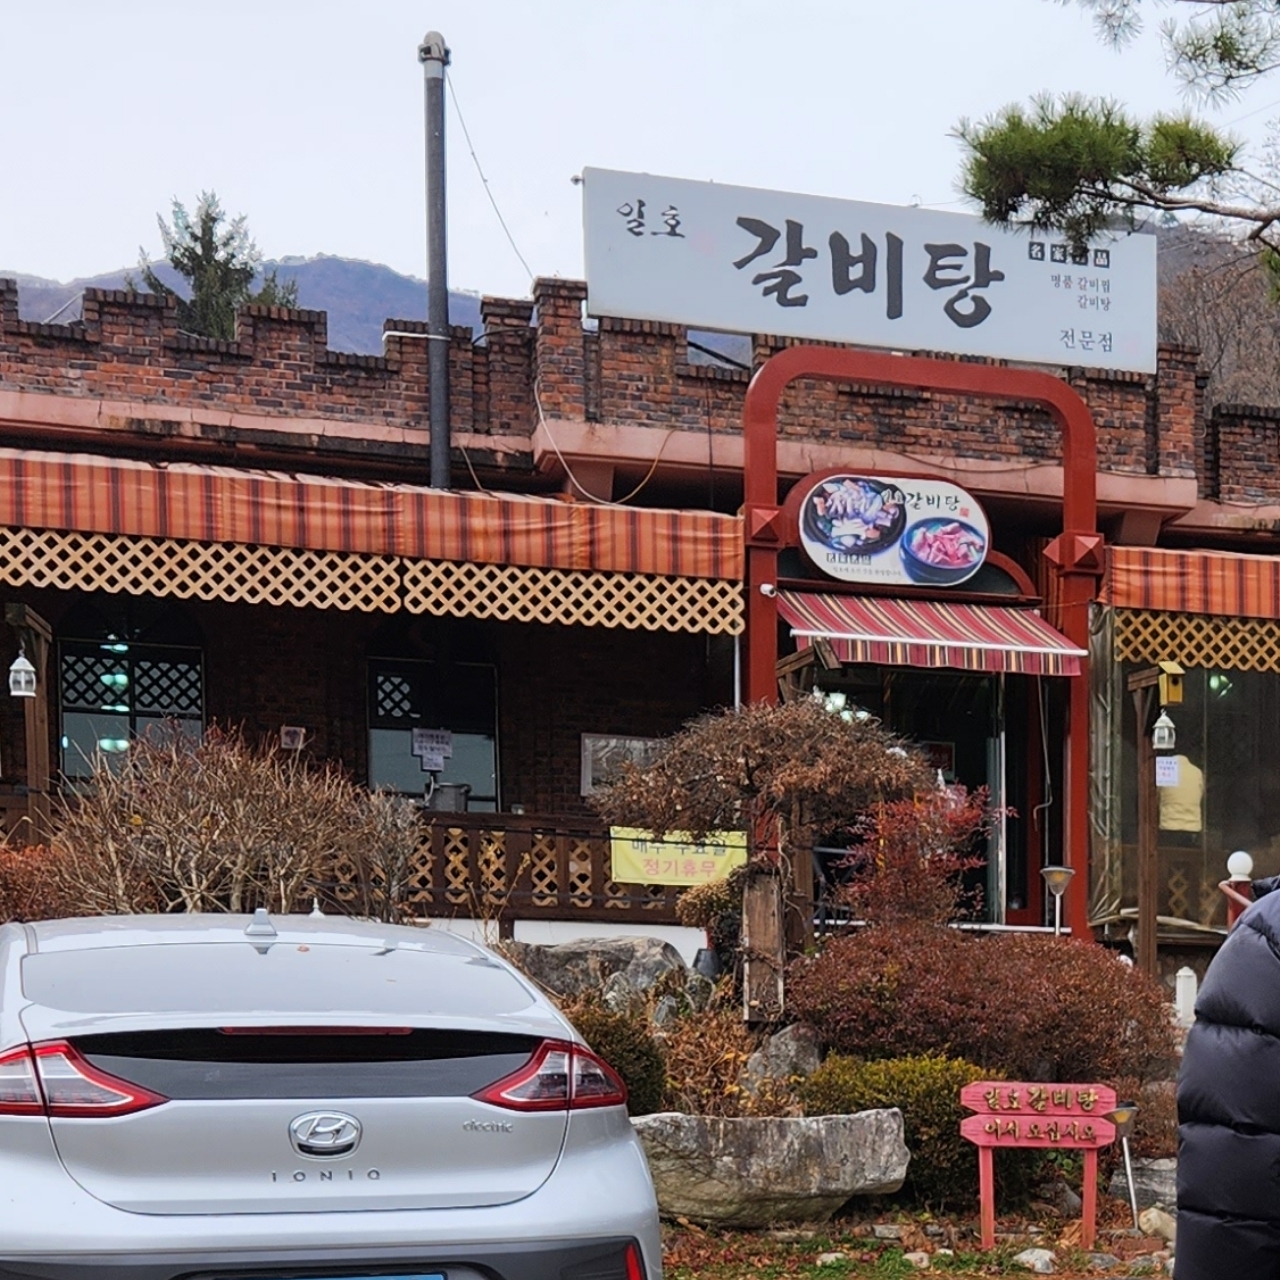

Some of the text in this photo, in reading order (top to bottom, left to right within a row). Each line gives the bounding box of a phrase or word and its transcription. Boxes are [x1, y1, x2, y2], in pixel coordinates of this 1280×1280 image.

[616, 198, 1005, 329] 일호 갈비탕
[1028, 241, 1111, 269] 名家品
[1059, 327, 1113, 353] 전문점
[643, 858, 717, 878] 정기휴무
[462, 1119, 514, 1134] electric
[271, 1167, 381, 1183] IONIQ
